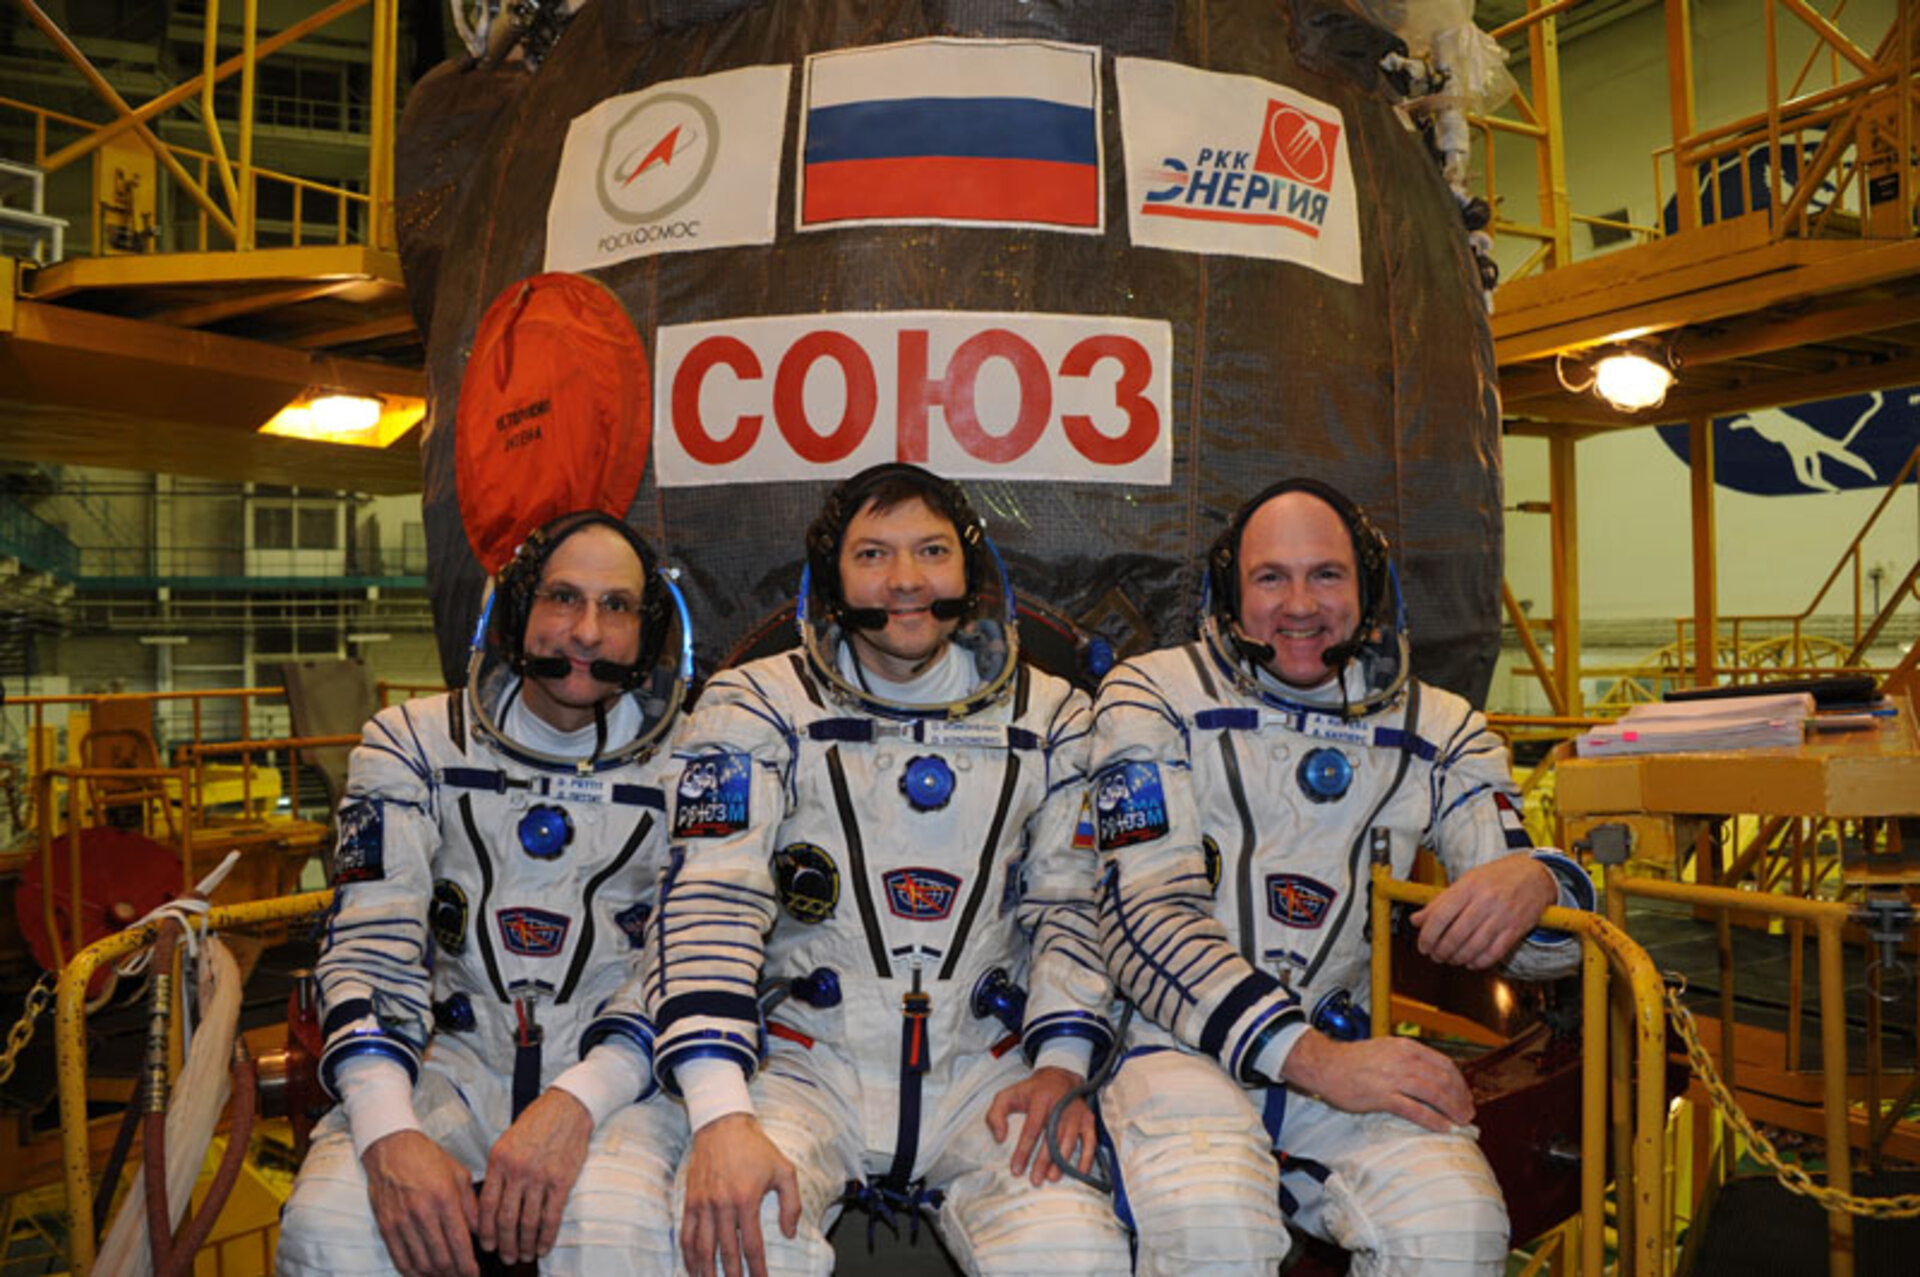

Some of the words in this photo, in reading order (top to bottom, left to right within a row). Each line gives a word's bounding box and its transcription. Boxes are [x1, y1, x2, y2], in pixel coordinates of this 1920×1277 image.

[1196, 148, 1250, 170] РКК
[1143, 157, 1330, 226] ЭНЕРГИЯ
[597, 220, 701, 252] РОСКОСМОС
[671, 328, 1161, 466] СОЮЗ
